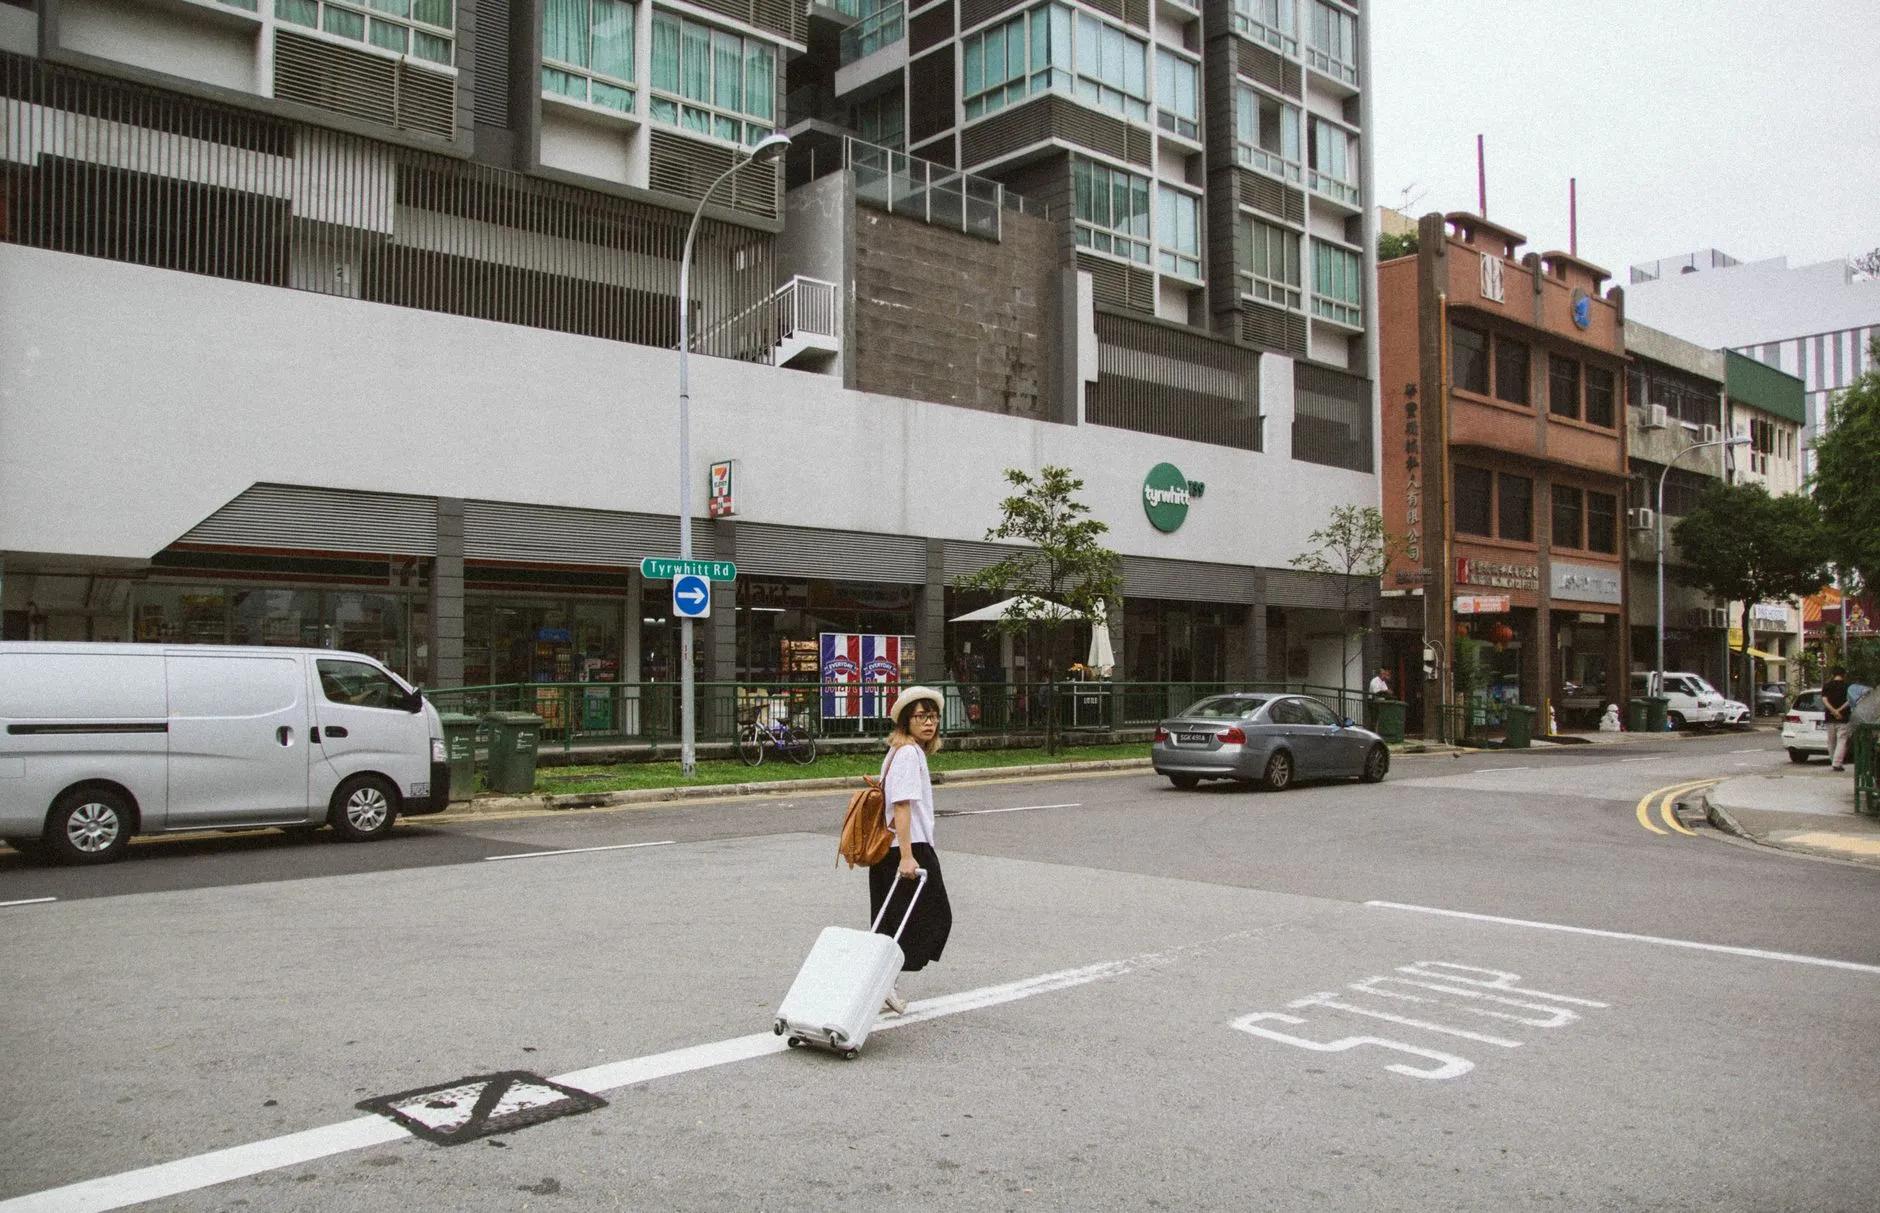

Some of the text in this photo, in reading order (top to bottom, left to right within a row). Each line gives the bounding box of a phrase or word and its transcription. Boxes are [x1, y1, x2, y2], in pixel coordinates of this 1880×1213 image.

[1145, 484, 1190, 506] tyrwhitt
[650, 561, 729, 576] Tyrwhitt Rd
[828, 661, 854, 671] EVERYDAY
[868, 662, 893, 672] EVERYDAY
[1227, 961, 1611, 1080] STOP
